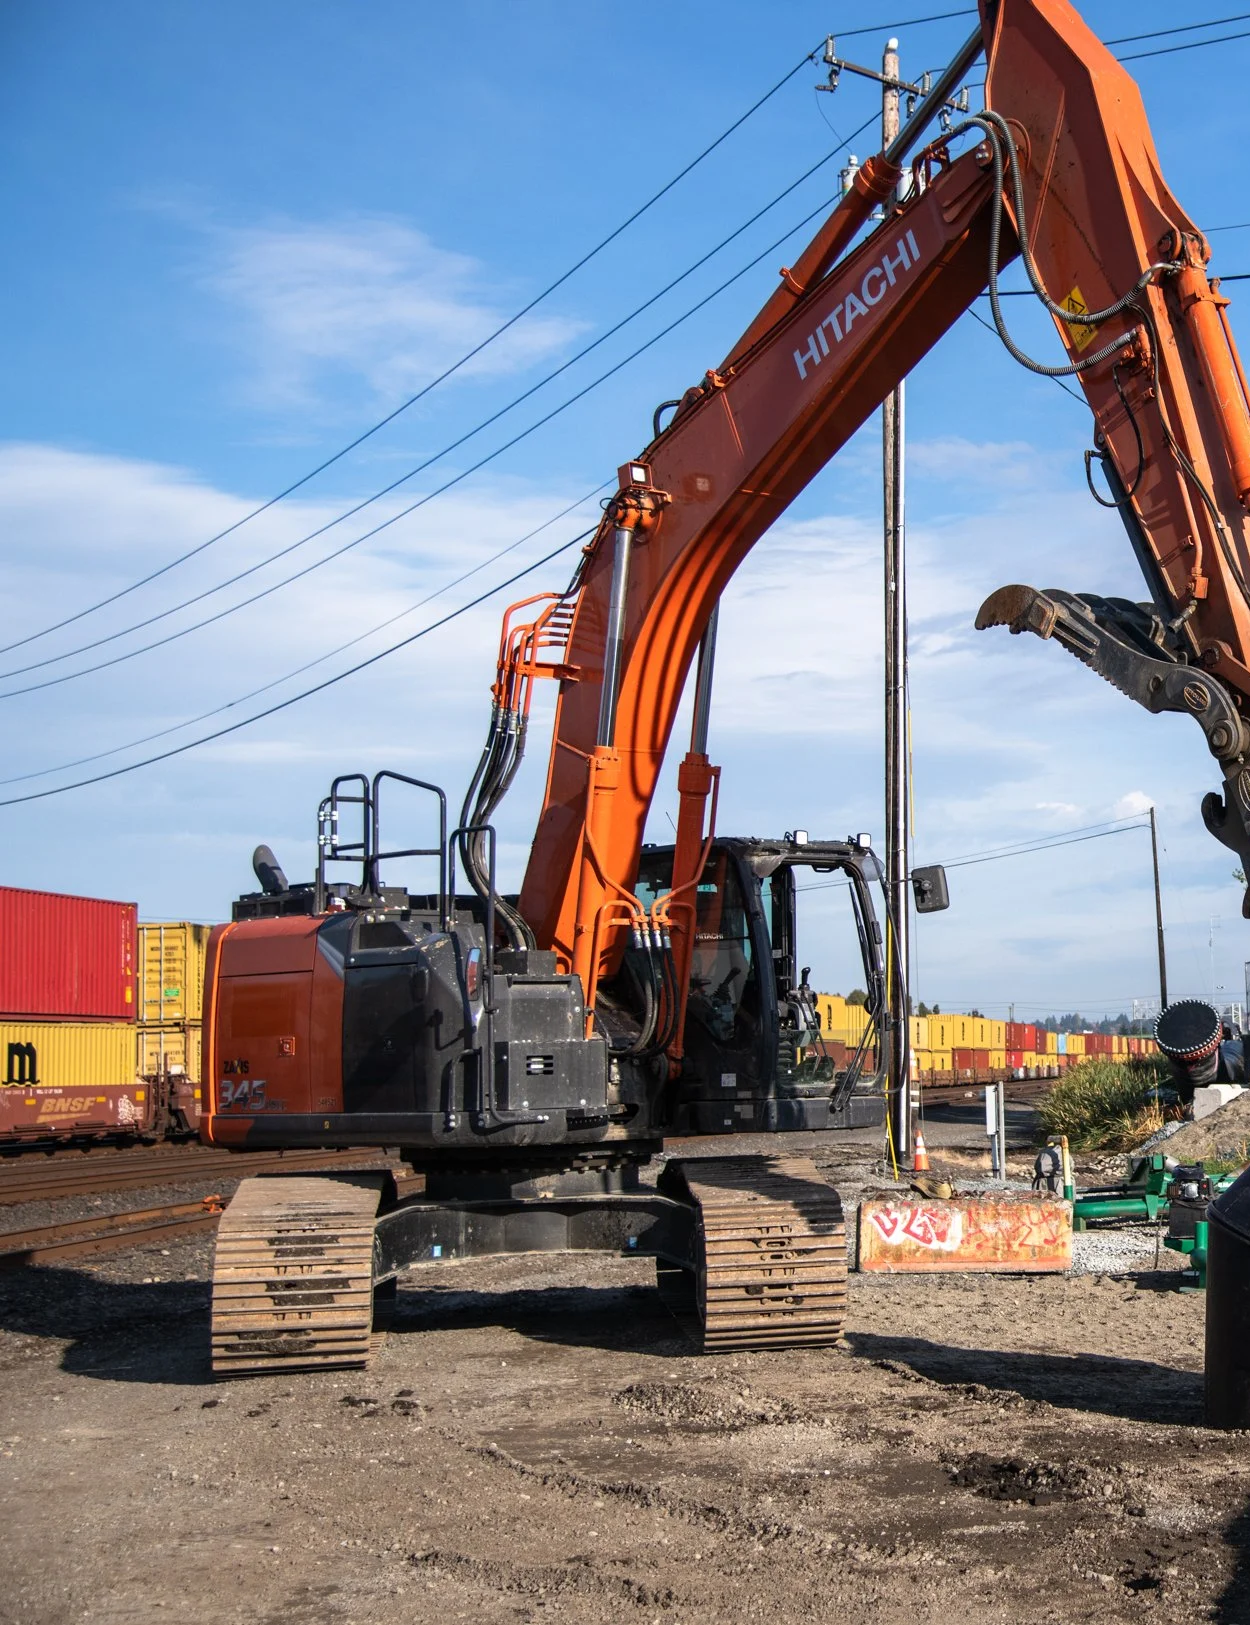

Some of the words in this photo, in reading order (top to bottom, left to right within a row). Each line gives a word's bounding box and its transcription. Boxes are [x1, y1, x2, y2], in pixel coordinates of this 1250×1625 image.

[793, 229, 921, 380] HITACHI
[695, 932, 724, 940] HITACHI
[40, 1097, 96, 1113] BNSF
[219, 1080, 267, 1110] 345
